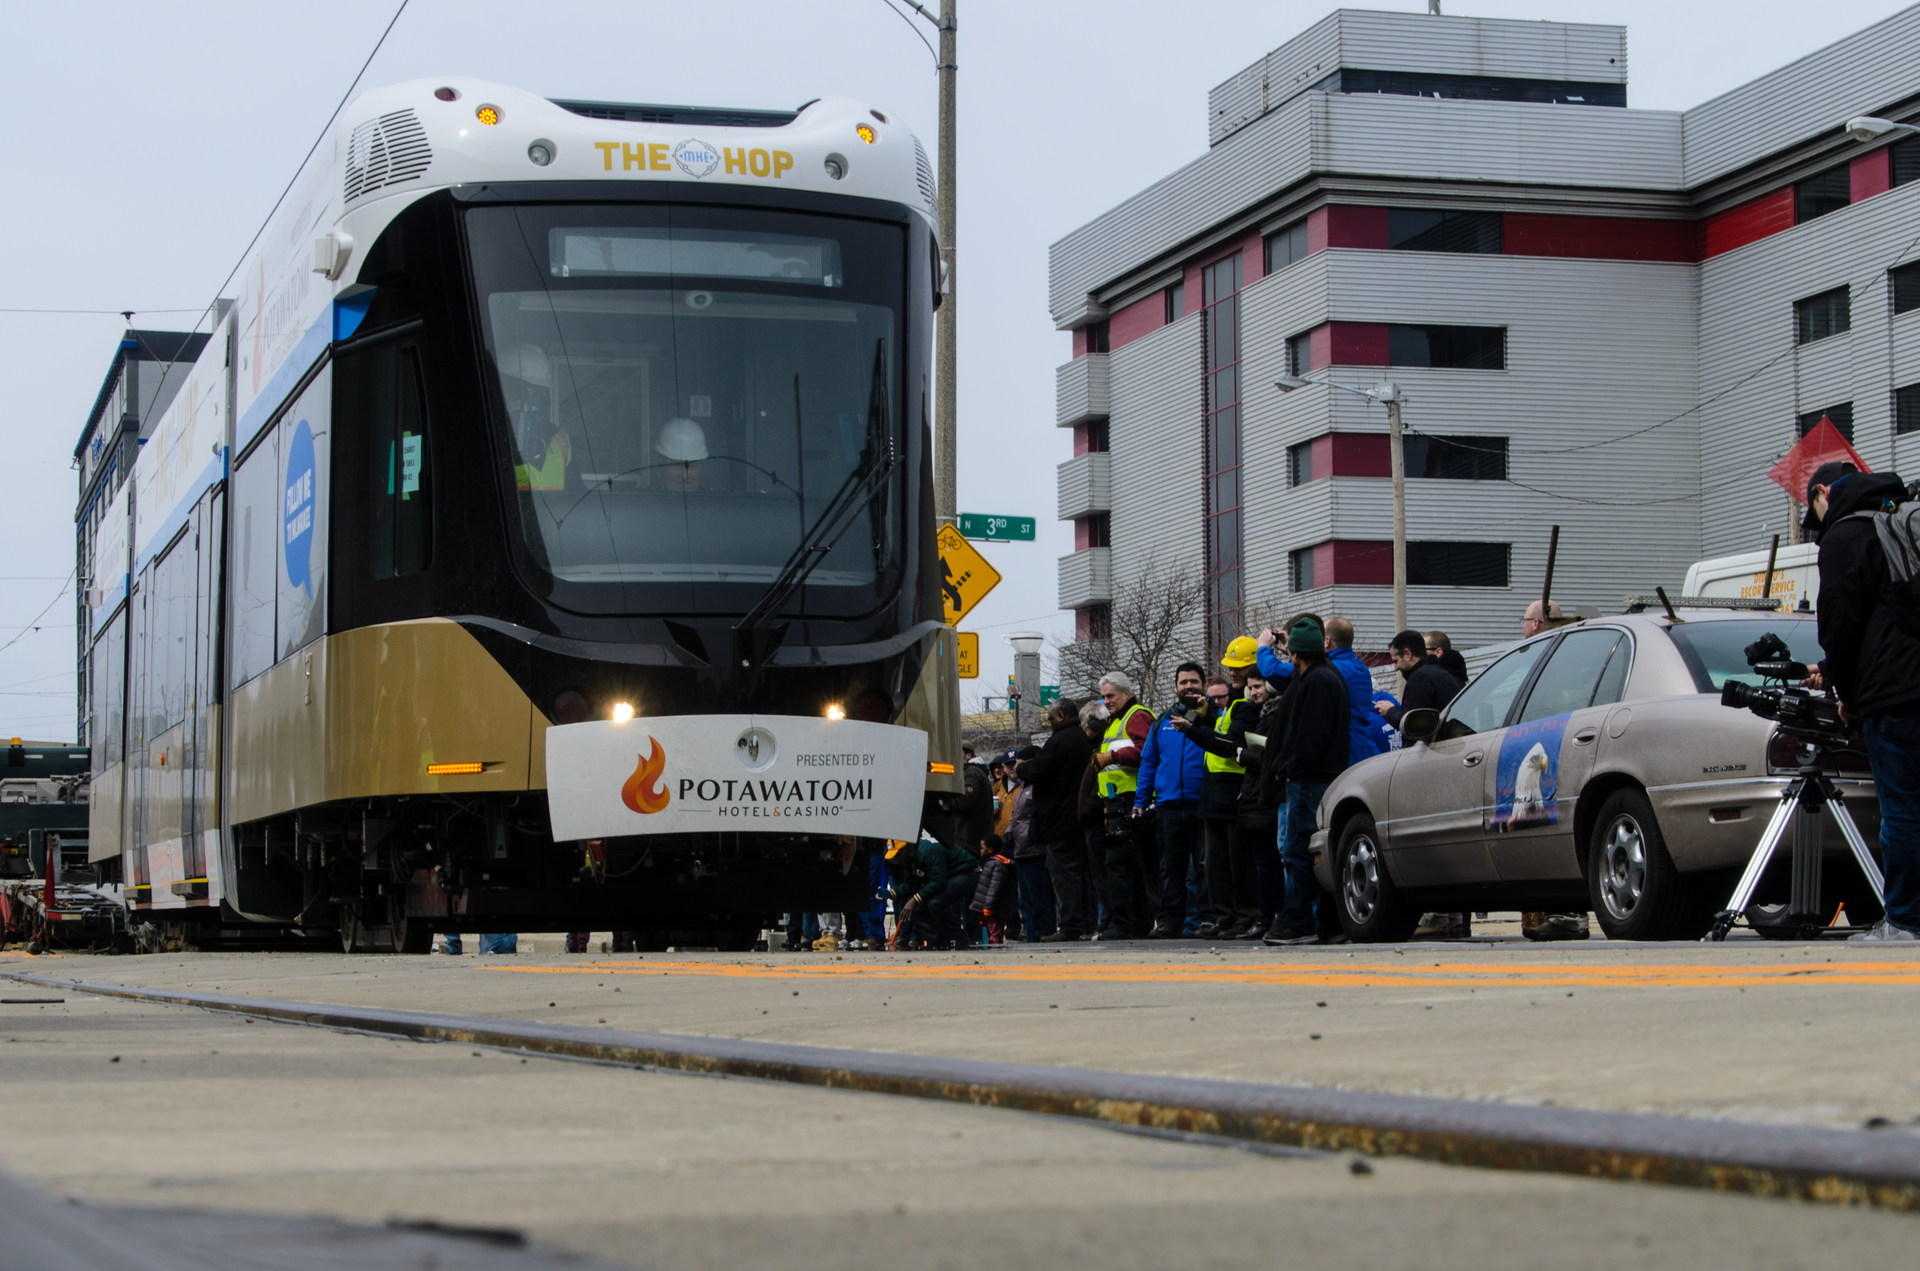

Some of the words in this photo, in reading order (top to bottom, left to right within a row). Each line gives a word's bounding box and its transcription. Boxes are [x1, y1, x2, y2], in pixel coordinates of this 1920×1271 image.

[594, 141, 672, 171] THE
[722, 146, 794, 179] HOP
[965, 520, 971, 530] N
[986, 517, 1007, 536] 3RD
[1020, 524, 1031, 534] ST
[1770, 580, 1795, 594] ERVICE
[1788, 593, 1797, 601] PA
[960, 650, 969, 660] AT
[958, 664, 973, 673] GLE
[796, 754, 860, 767] PRESENTED
[862, 753, 876, 766] BY
[678, 778, 873, 802] POTAWATOMI
